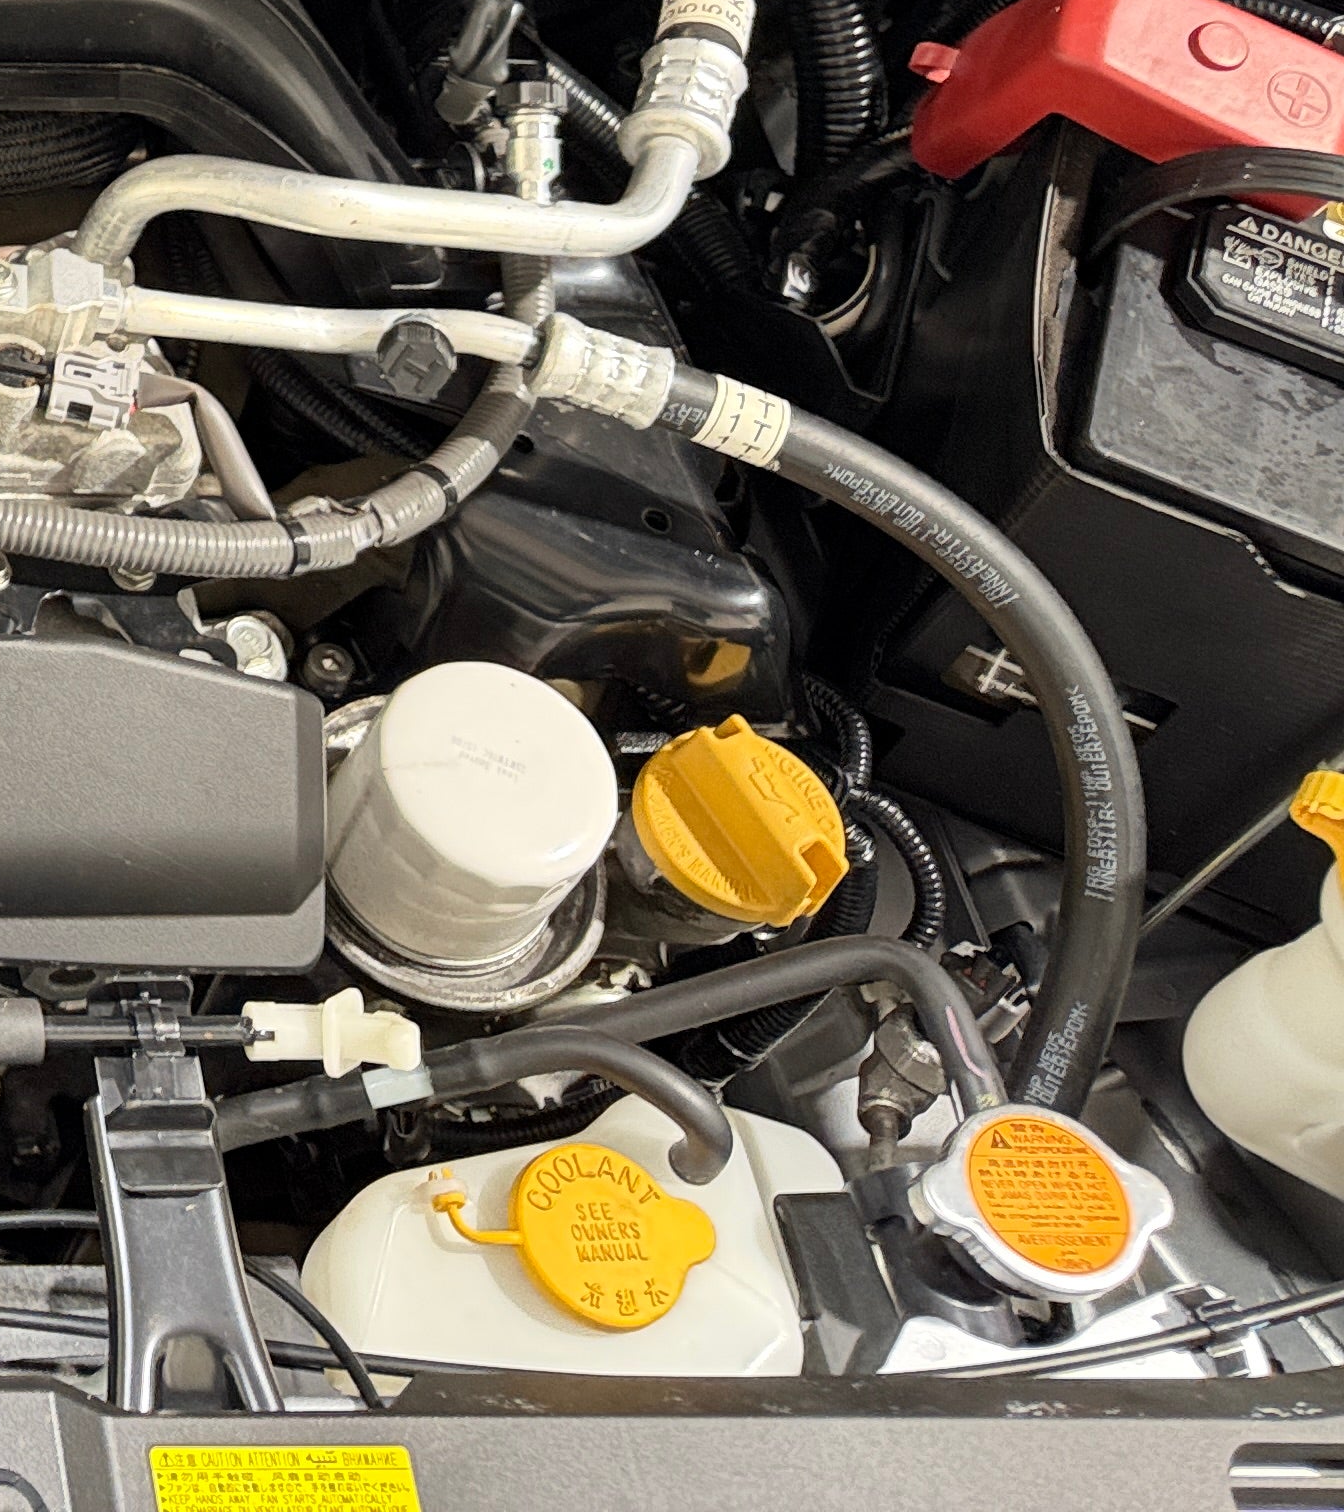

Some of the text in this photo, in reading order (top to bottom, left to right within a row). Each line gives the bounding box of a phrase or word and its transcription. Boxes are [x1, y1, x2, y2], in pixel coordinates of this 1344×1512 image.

[1262, 223, 1344, 266] DANGE
[526, 1152, 662, 1211] COOLANT
[575, 1202, 613, 1221] SEE
[570, 1221, 642, 1242] OWNERS
[575, 1242, 649, 1263] MANUAL
[201, 1452, 243, 1467] CAUTION
[249, 1452, 300, 1467] ATTENTION
[169, 1494, 191, 1505] KEEP
[195, 1494, 224, 1504] HANDS
[261, 1494, 279, 1505] FAN
[282, 1494, 316, 1505] STARTS
